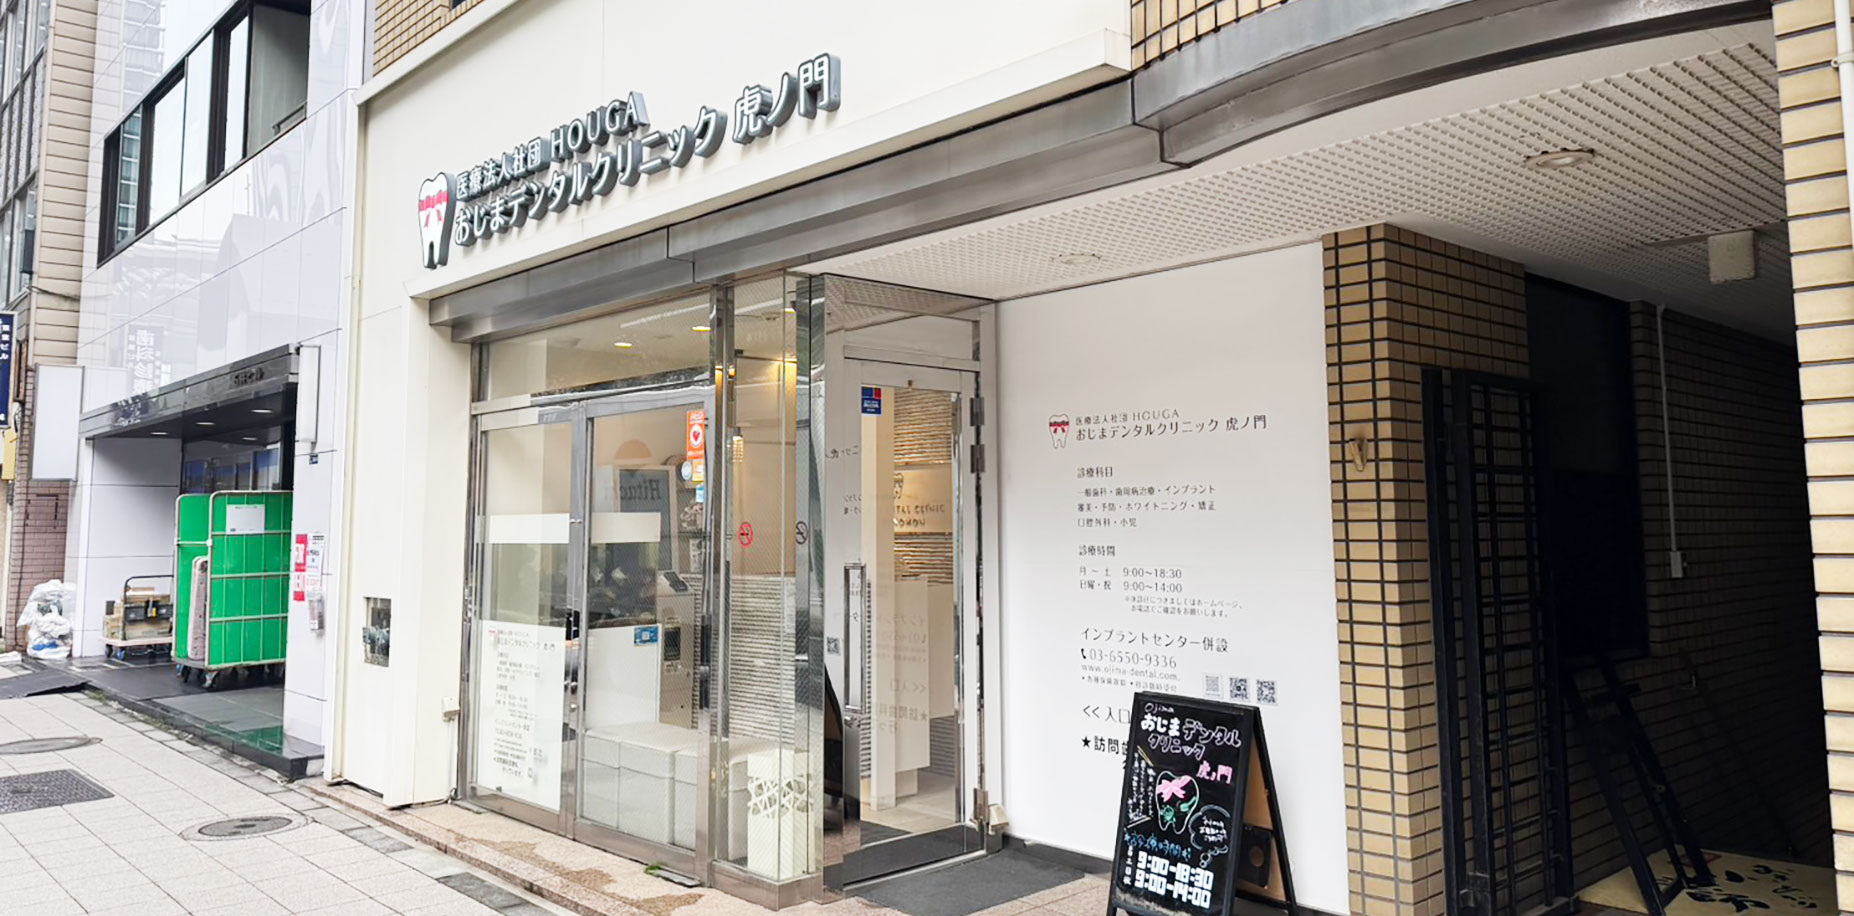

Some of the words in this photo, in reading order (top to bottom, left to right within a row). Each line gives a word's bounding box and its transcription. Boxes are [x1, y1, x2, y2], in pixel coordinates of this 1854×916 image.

[454, 106, 727, 247] おじまデンタルクリニック
[731, 52, 841, 145] 虎ノ門
[455, 137, 552, 201] 医療法人社団
[550, 91, 650, 163] HOUGA
[1075, 413, 1128, 426] 医療法人社団
[1132, 408, 1181, 422] HOUGA
[1075, 418, 1219, 441] おじまデンタルクリニック
[1225, 414, 1267, 432] 虎ノ門
[1076, 466, 1113, 479] 診療科目
[1078, 545, 1116, 557] 診療時間
[1081, 627, 1228, 653] インプラントセンター併設
[1089, 648, 1177, 669] 03-6550-9336
[1148, 733, 1206, 760] クリニック
[1196, 760, 1233, 785] 虎ノ門
